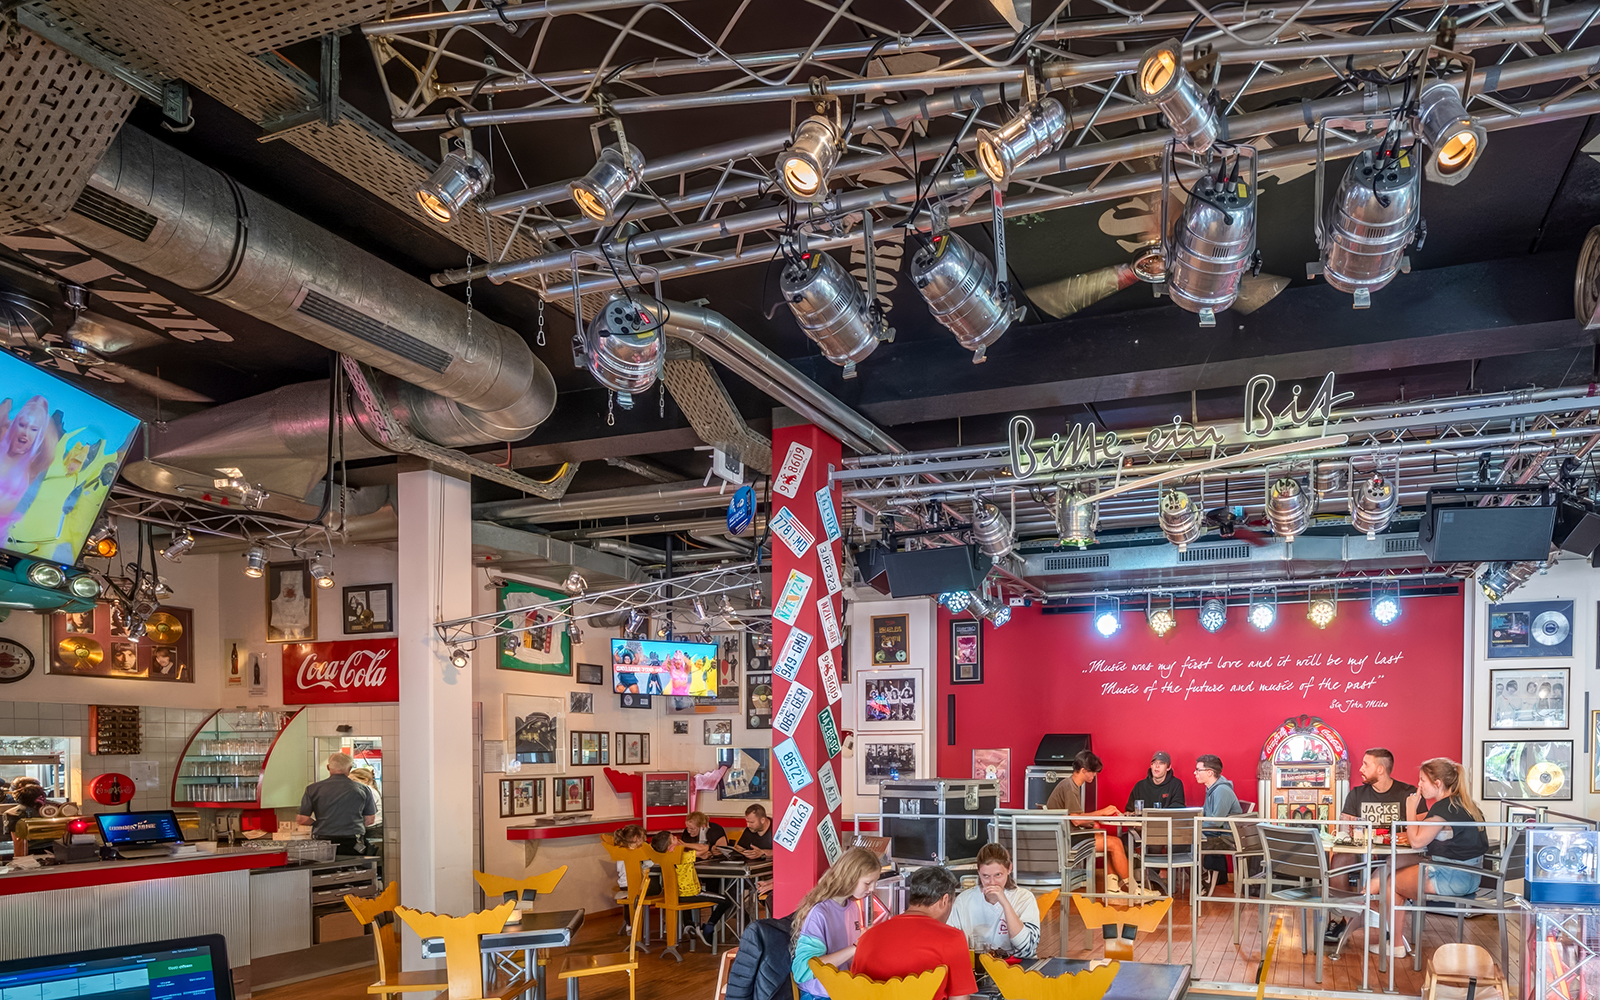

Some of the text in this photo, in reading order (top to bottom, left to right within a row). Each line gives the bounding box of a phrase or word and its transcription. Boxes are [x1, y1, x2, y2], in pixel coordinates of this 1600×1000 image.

[1143, 414, 1225, 454] ein
[1243, 370, 1356, 438] Bit
[786, 446, 806, 473] 8609
[296, 648, 392, 690] Coca-Cola
[1132, 662, 1154, 671] was
[1158, 661, 1177, 678] my
[1179, 656, 1213, 677] first
[1217, 656, 1243, 669] love
[1247, 656, 1273, 668] and
[1277, 655, 1291, 667] it
[1296, 653, 1322, 667] will
[1326, 654, 1343, 666] be
[1347, 655, 1368, 674] my
[1374, 652, 1404, 665] last
[1101, 682, 1139, 696] Music
[1143, 680, 1158, 701] of
[1161, 680, 1182, 693] the
[1184, 679, 1225, 700] future
[1230, 680, 1255, 693] and
[1259, 680, 1294, 692] music
[1299, 676, 1315, 698] of
[1318, 677, 1342, 690] the
[1364, 814, 1399, 824] JONES
